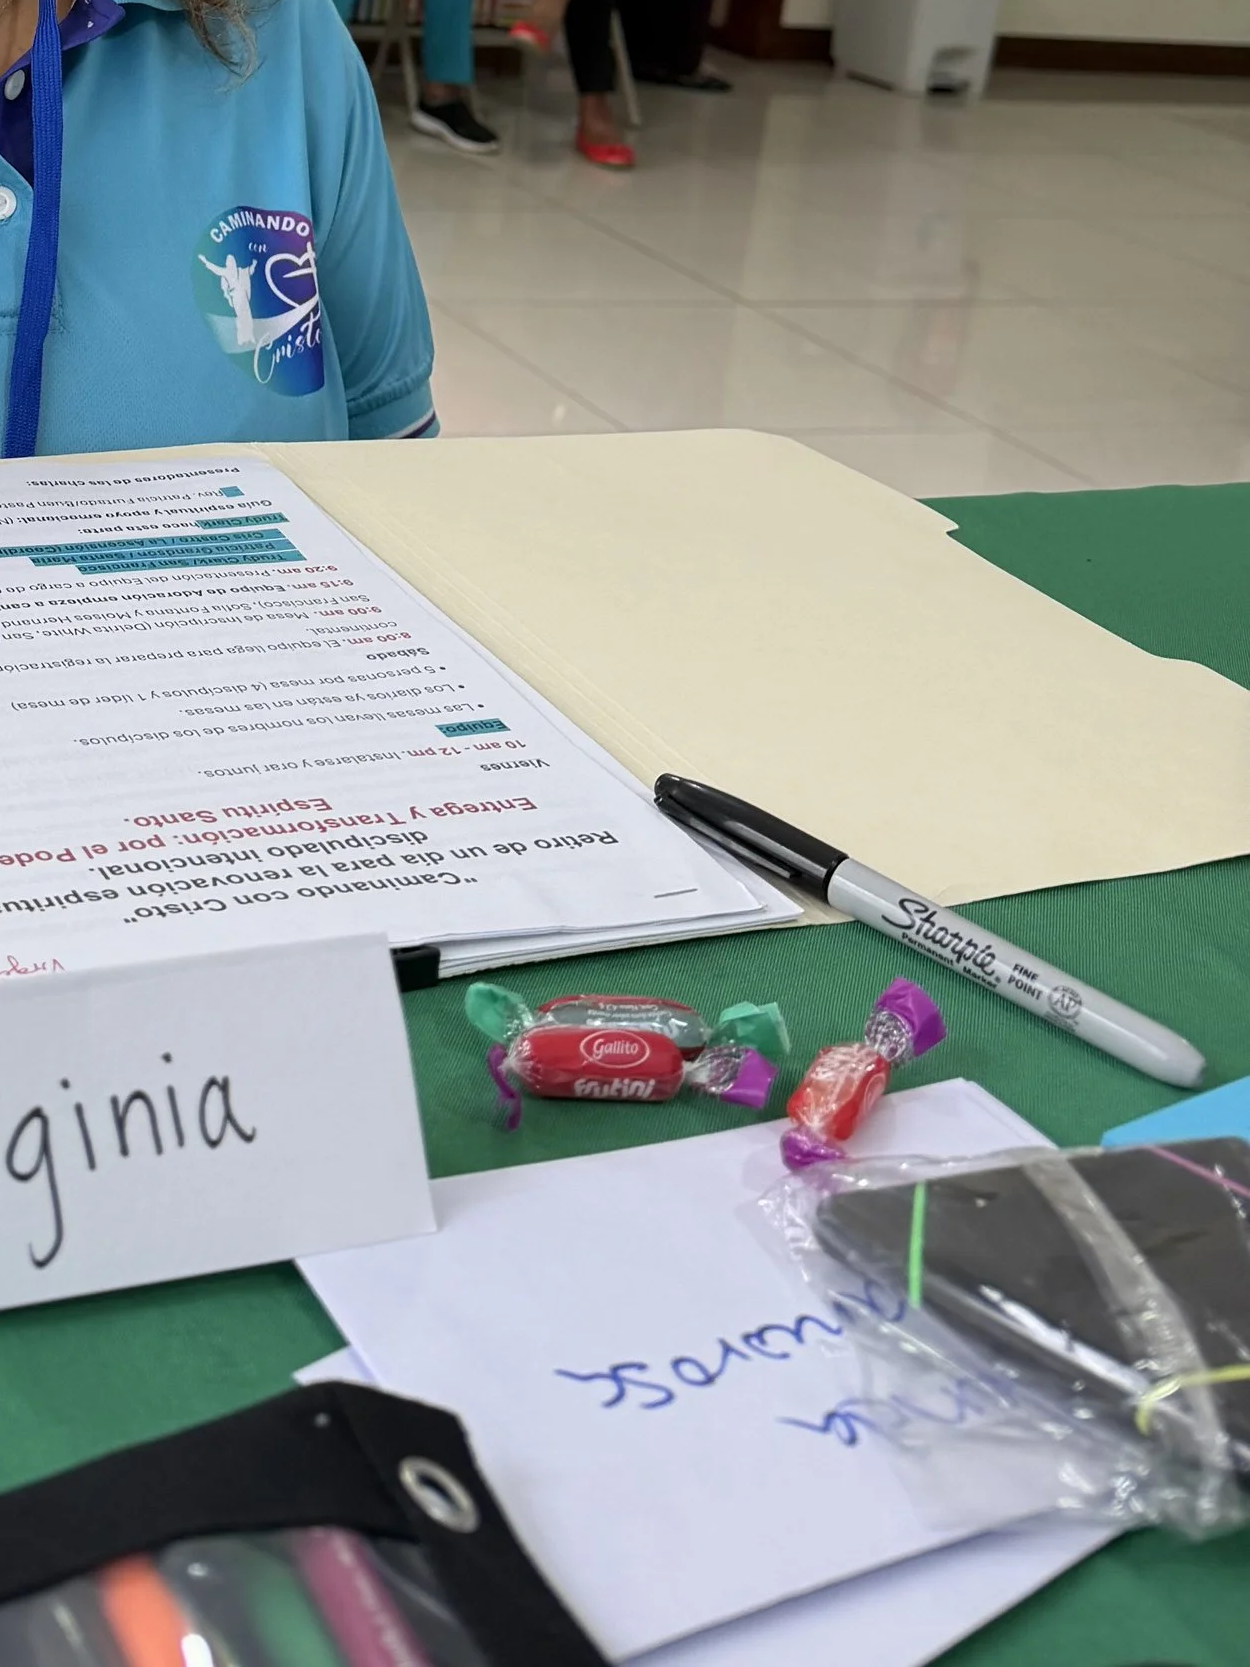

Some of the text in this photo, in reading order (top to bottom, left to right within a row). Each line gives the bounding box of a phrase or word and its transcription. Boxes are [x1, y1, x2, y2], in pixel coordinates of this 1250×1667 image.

[209, 209, 311, 244] CAMINANDO
[248, 242, 270, 254] con
[305, 621, 398, 636] continental.
[376, 631, 412, 643] 8:00
[186, 647, 224, 658] para
[267, 640, 322, 651] equipo
[115, 649, 185, 663] preparar
[366, 647, 430, 661] Sábado
[318, 675, 346, 685] por
[347, 665, 422, 683] personas
[250, 681, 268, 692] (4
[269, 678, 316, 689] mesa
[423, 683, 456, 694] Los
[150, 690, 161, 700] y
[161, 684, 248, 698] discípulos
[344, 692, 366, 702] ya
[10, 699, 66, 712] mesa)
[95, 694, 134, 704] líder
[295, 696, 343, 706] están
[179, 705, 242, 716] mesas.
[386, 706, 442, 719] mesas
[443, 703, 475, 713] Las
[334, 712, 387, 723] llevan
[202, 726, 225, 736] de
[227, 718, 304, 733] nombres
[435, 719, 509, 737] Equipo:
[73, 731, 170, 746] discípulos.
[172, 728, 202, 738] los
[437, 746, 462, 756] 12
[472, 741, 502, 751] am
[504, 739, 527, 749] 10
[401, 746, 438, 757] pm.
[302, 758, 313, 768] y
[313, 751, 402, 767] Instalarse
[479, 758, 551, 772] Viernes
[197, 763, 262, 778] juntos.
[264, 761, 299, 772] orar
[123, 797, 333, 828] Espíritu Santo.
[409, 806, 428, 820] y
[428, 797, 538, 817] Entrega
[172, 812, 407, 846] Transformación:
[117, 834, 167, 853] por
[533, 830, 619, 850] Retiro
[81, 843, 109, 860] el
[88, 830, 429, 881] discipulado intencional.
[449, 846, 489, 859] un
[492, 841, 528, 856] de
[330, 853, 396, 873] para
[400, 851, 445, 867] día
[297, 864, 330, 878] la
[126, 868, 293, 898] renovación
[123, 871, 478, 924] "Caminando con Cristo"
[881, 897, 997, 978] Sharpie
[901, 931, 999, 991] Permanent Marker
[1011, 963, 1041, 982] FINE
[1006, 975, 1044, 1002] POINT
[592, 1038, 640, 1060] Gallito
[573, 1077, 657, 1100] frutini
